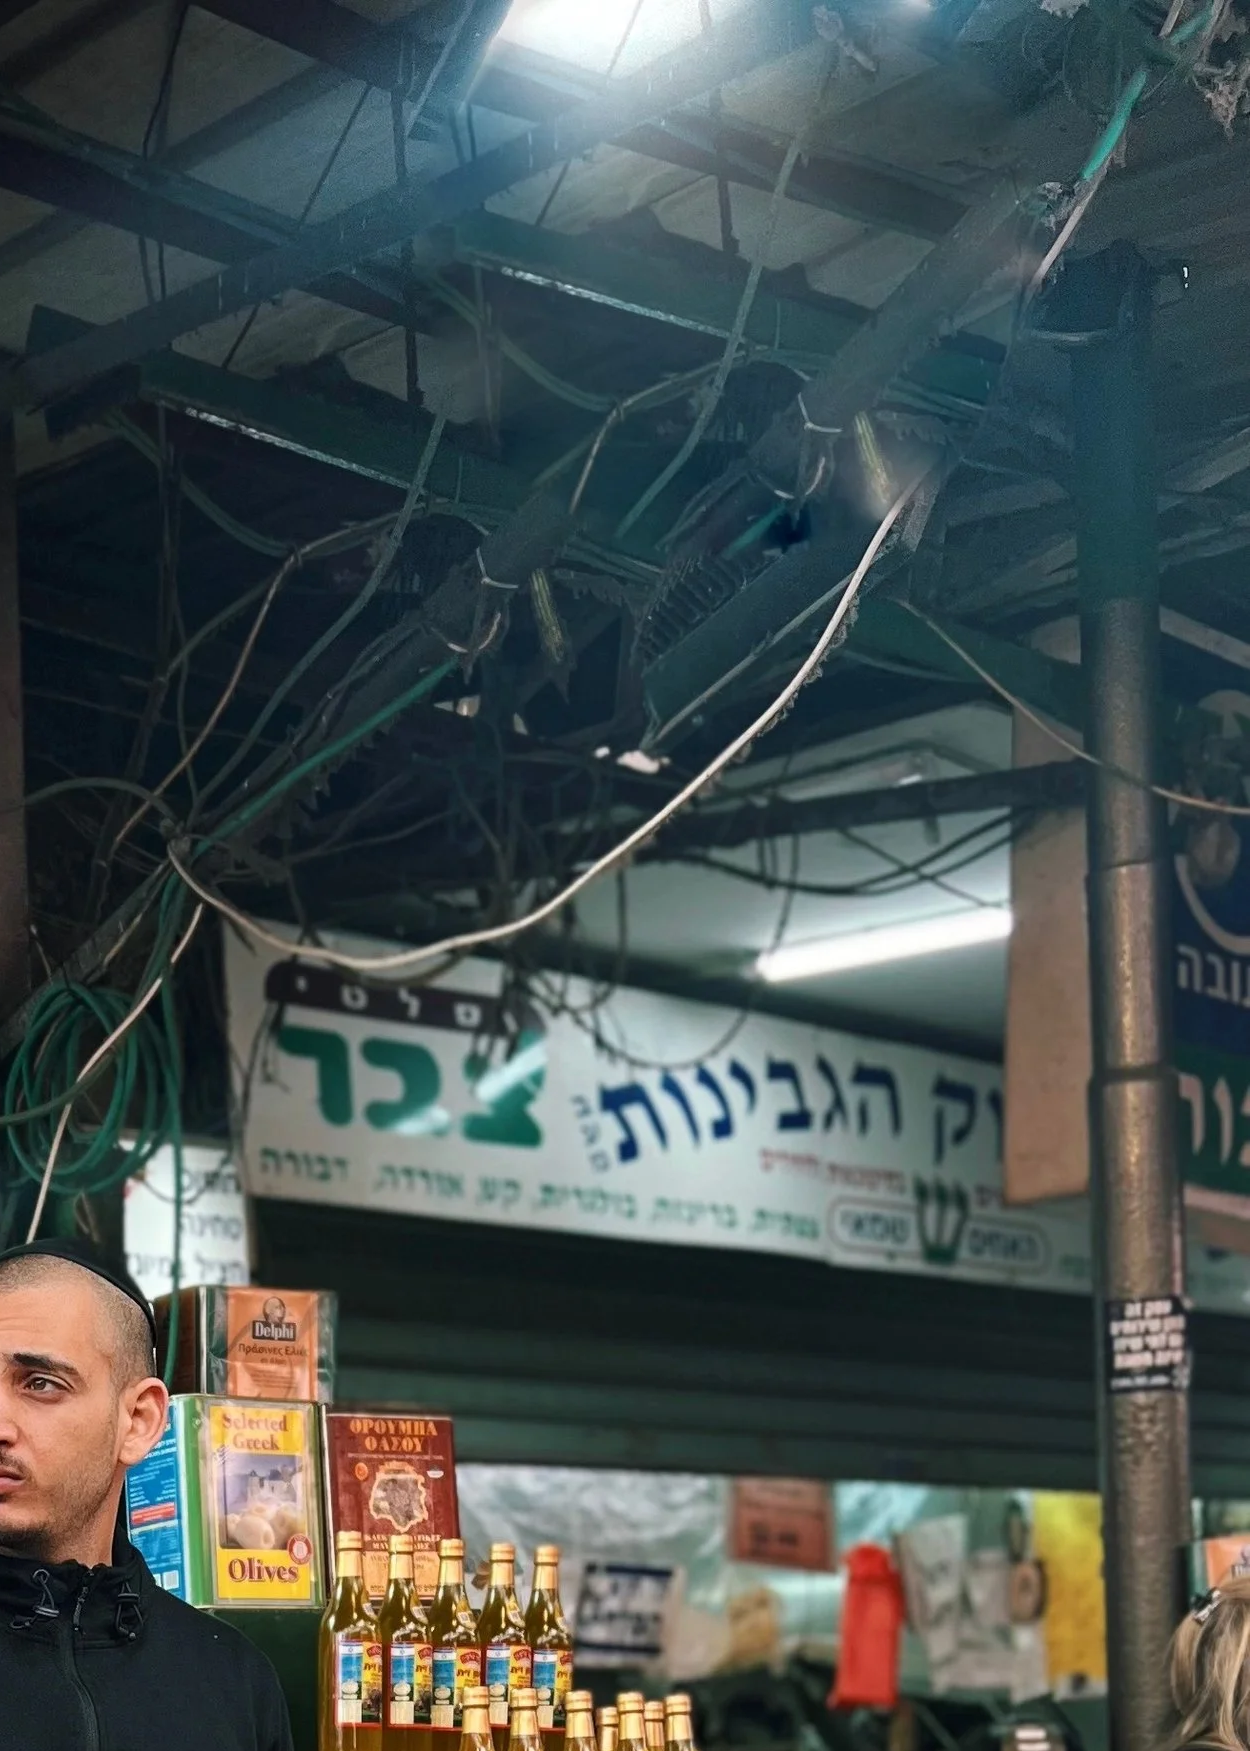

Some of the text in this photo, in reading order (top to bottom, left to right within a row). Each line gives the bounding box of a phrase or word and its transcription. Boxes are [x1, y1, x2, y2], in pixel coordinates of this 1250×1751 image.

[255, 1322, 295, 1341] Delphi
[222, 1412, 289, 1433] Selected
[232, 1432, 280, 1452] Greek
[364, 1436, 425, 1453] ΘΑΣΟΥ
[228, 1557, 300, 1584] Olives
